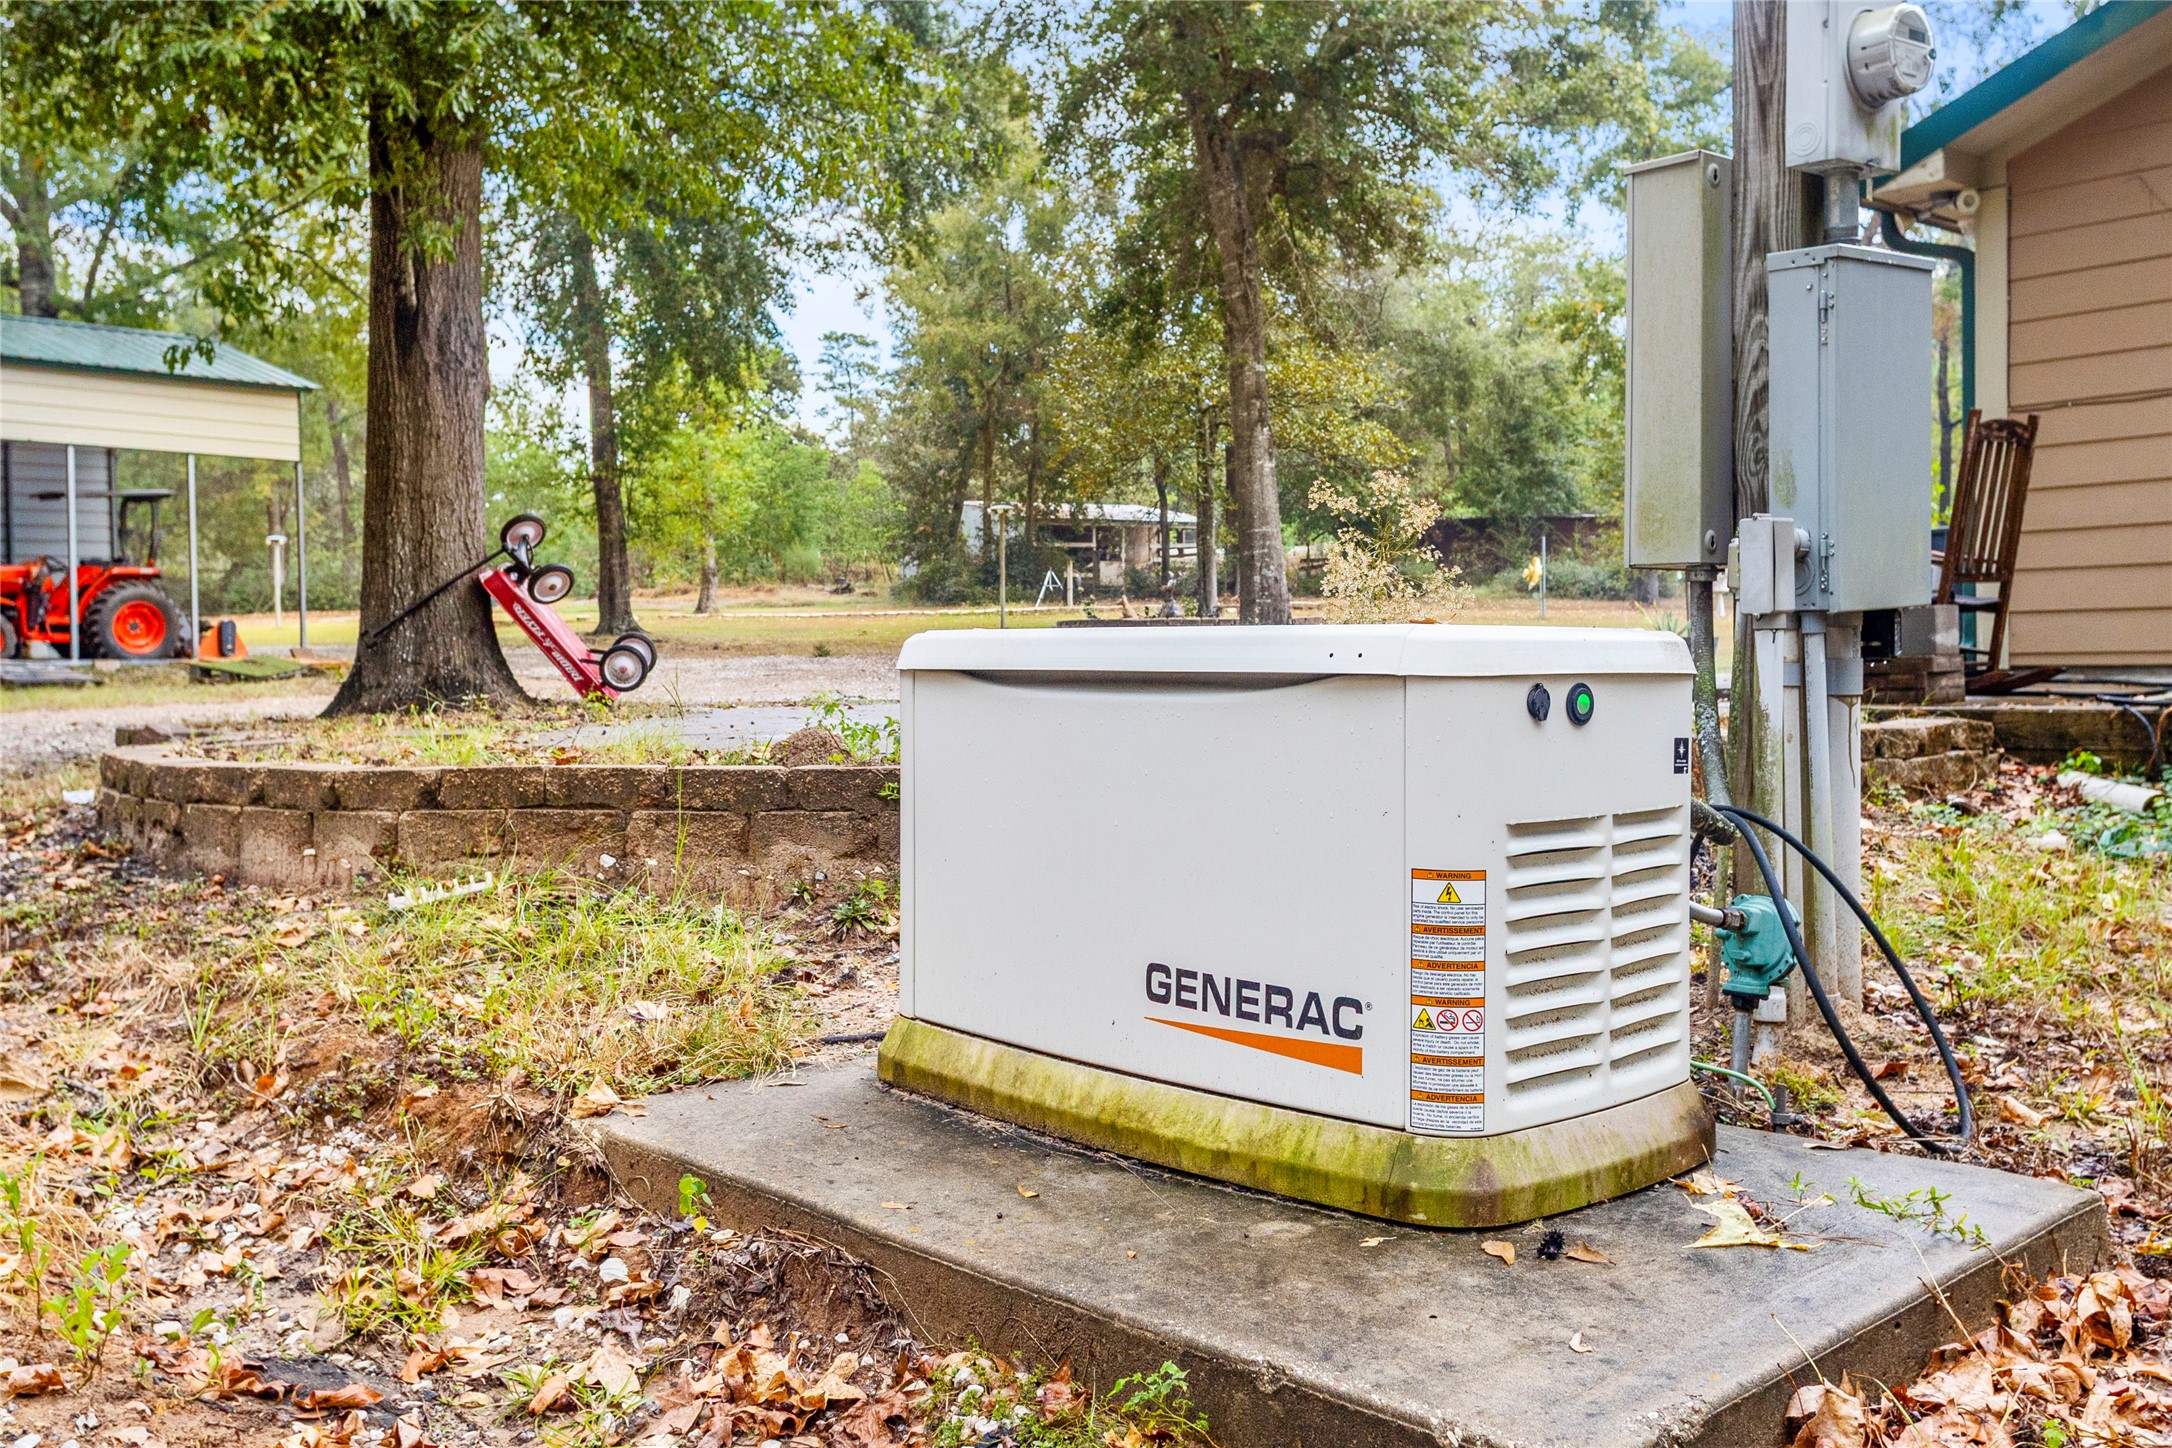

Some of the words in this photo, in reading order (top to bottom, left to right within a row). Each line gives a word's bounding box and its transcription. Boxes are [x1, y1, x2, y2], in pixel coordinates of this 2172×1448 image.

[1423, 926, 1483, 934] AVERTISSEMENT
[1427, 962, 1478, 970] ADVERTENCIA
[1422, 1057, 1482, 1065] AVERTISSEMENT
[1426, 1094, 1477, 1102] ADVERTENCIA
